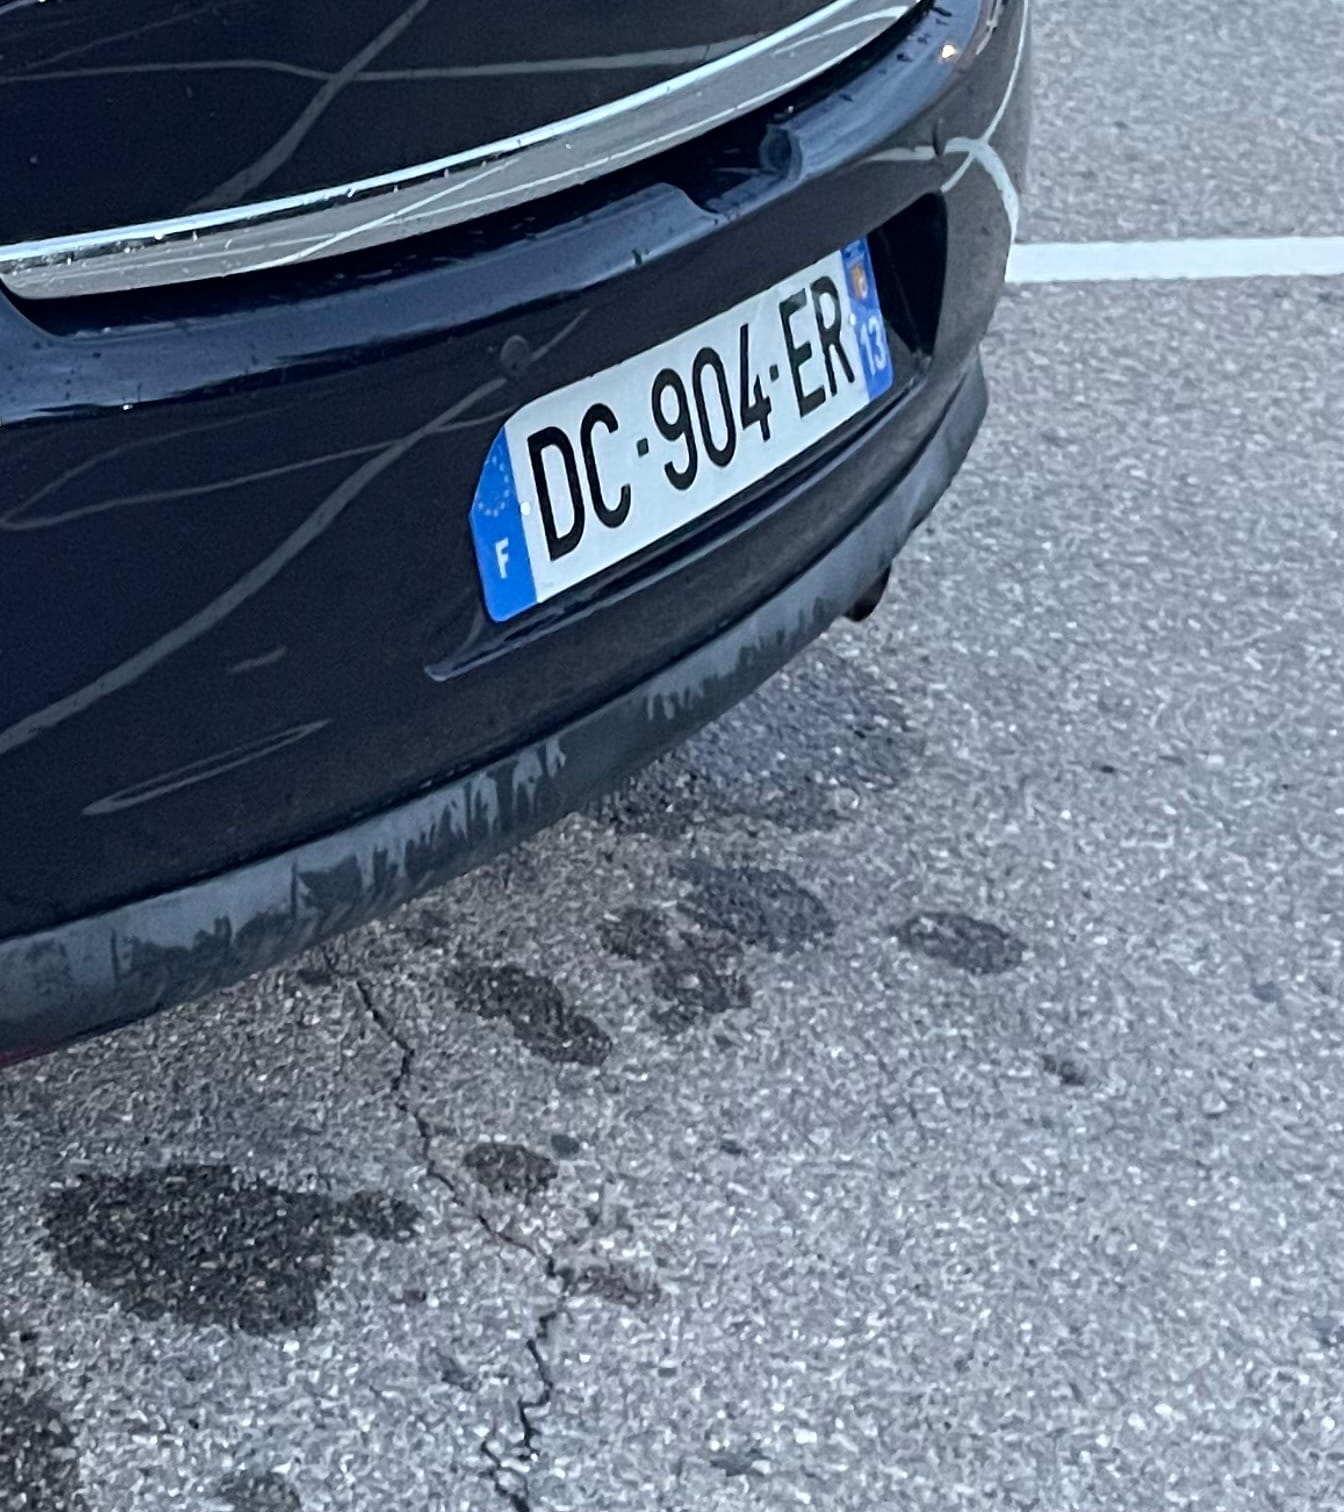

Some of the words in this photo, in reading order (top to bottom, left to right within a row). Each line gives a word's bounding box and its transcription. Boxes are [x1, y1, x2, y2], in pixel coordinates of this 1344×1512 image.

[860, 315, 888, 376] 13
[527, 275, 856, 562] DC-904-ER
[495, 537, 509, 579] F
